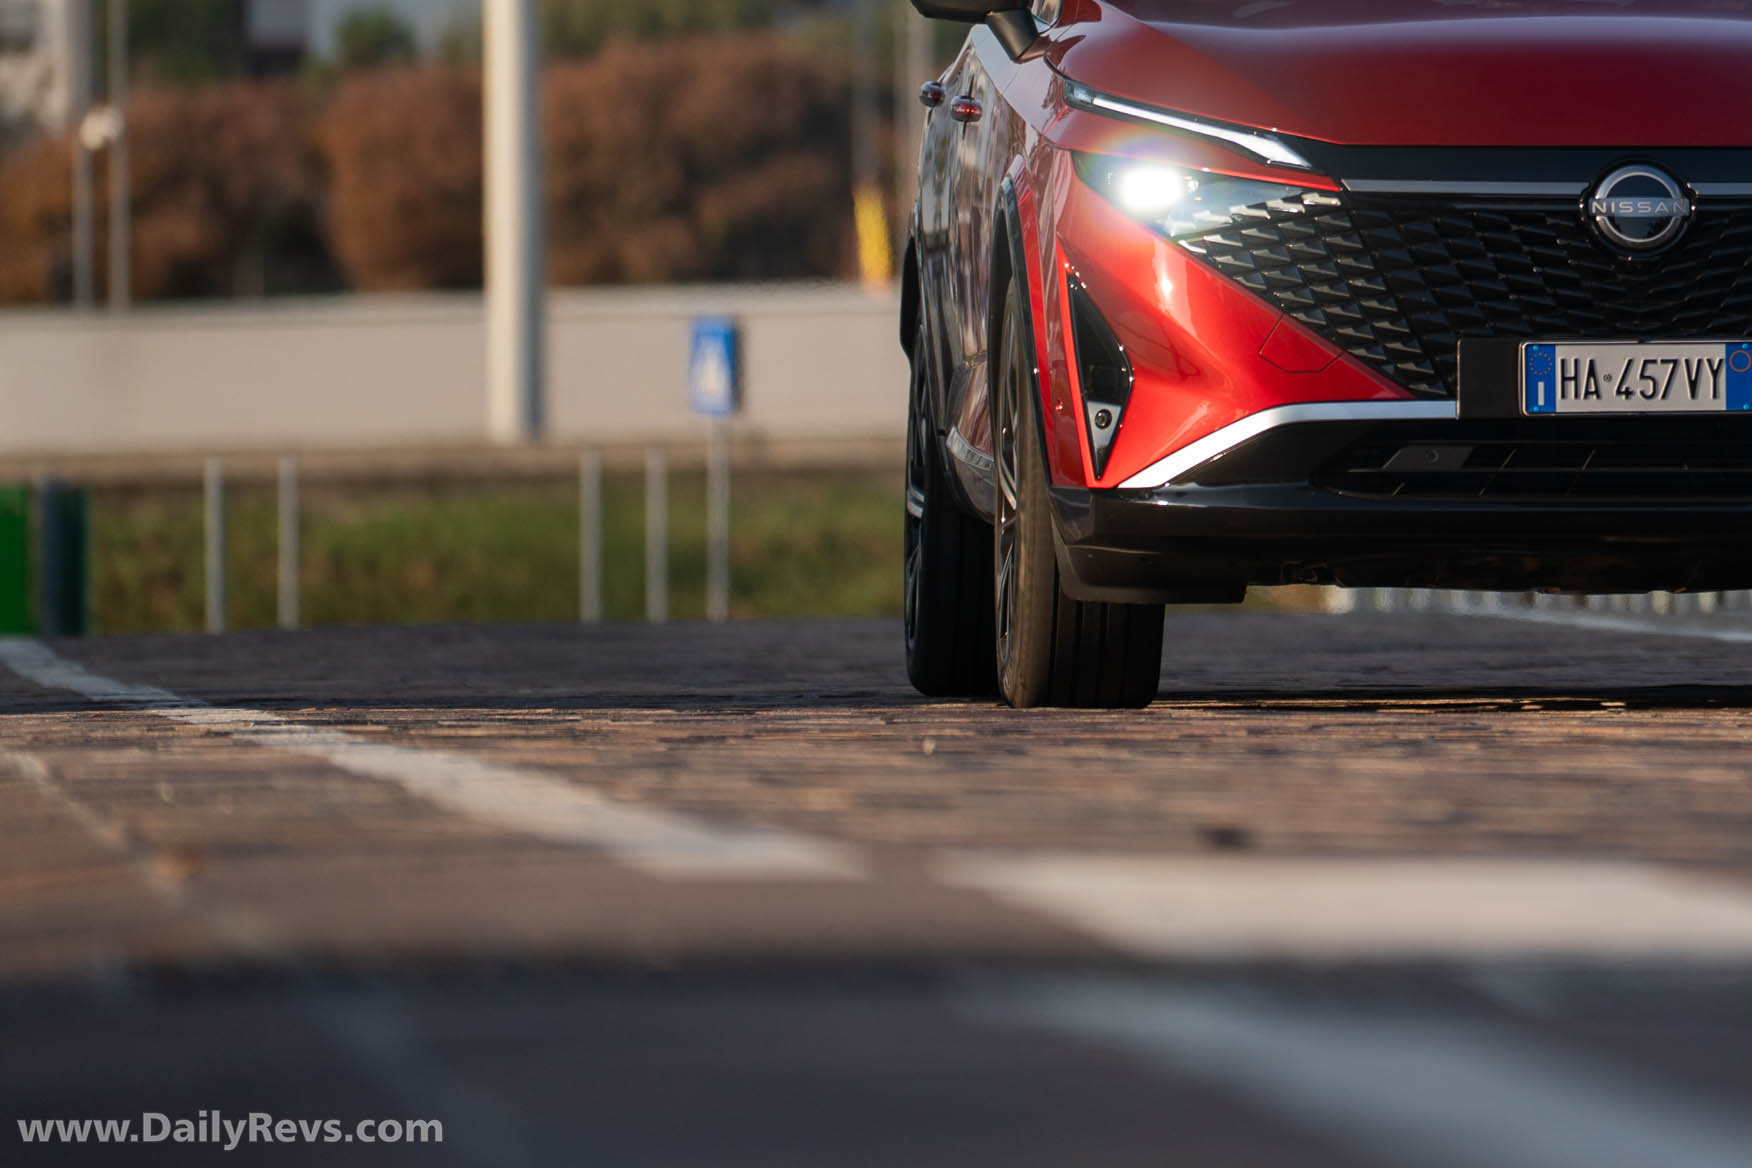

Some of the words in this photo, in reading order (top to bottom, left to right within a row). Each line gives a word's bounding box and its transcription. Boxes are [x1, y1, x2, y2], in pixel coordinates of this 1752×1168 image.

[1591, 200, 1688, 214] NISSAN
[1560, 358, 1602, 400] HA
[1615, 358, 1724, 400] 457VY
